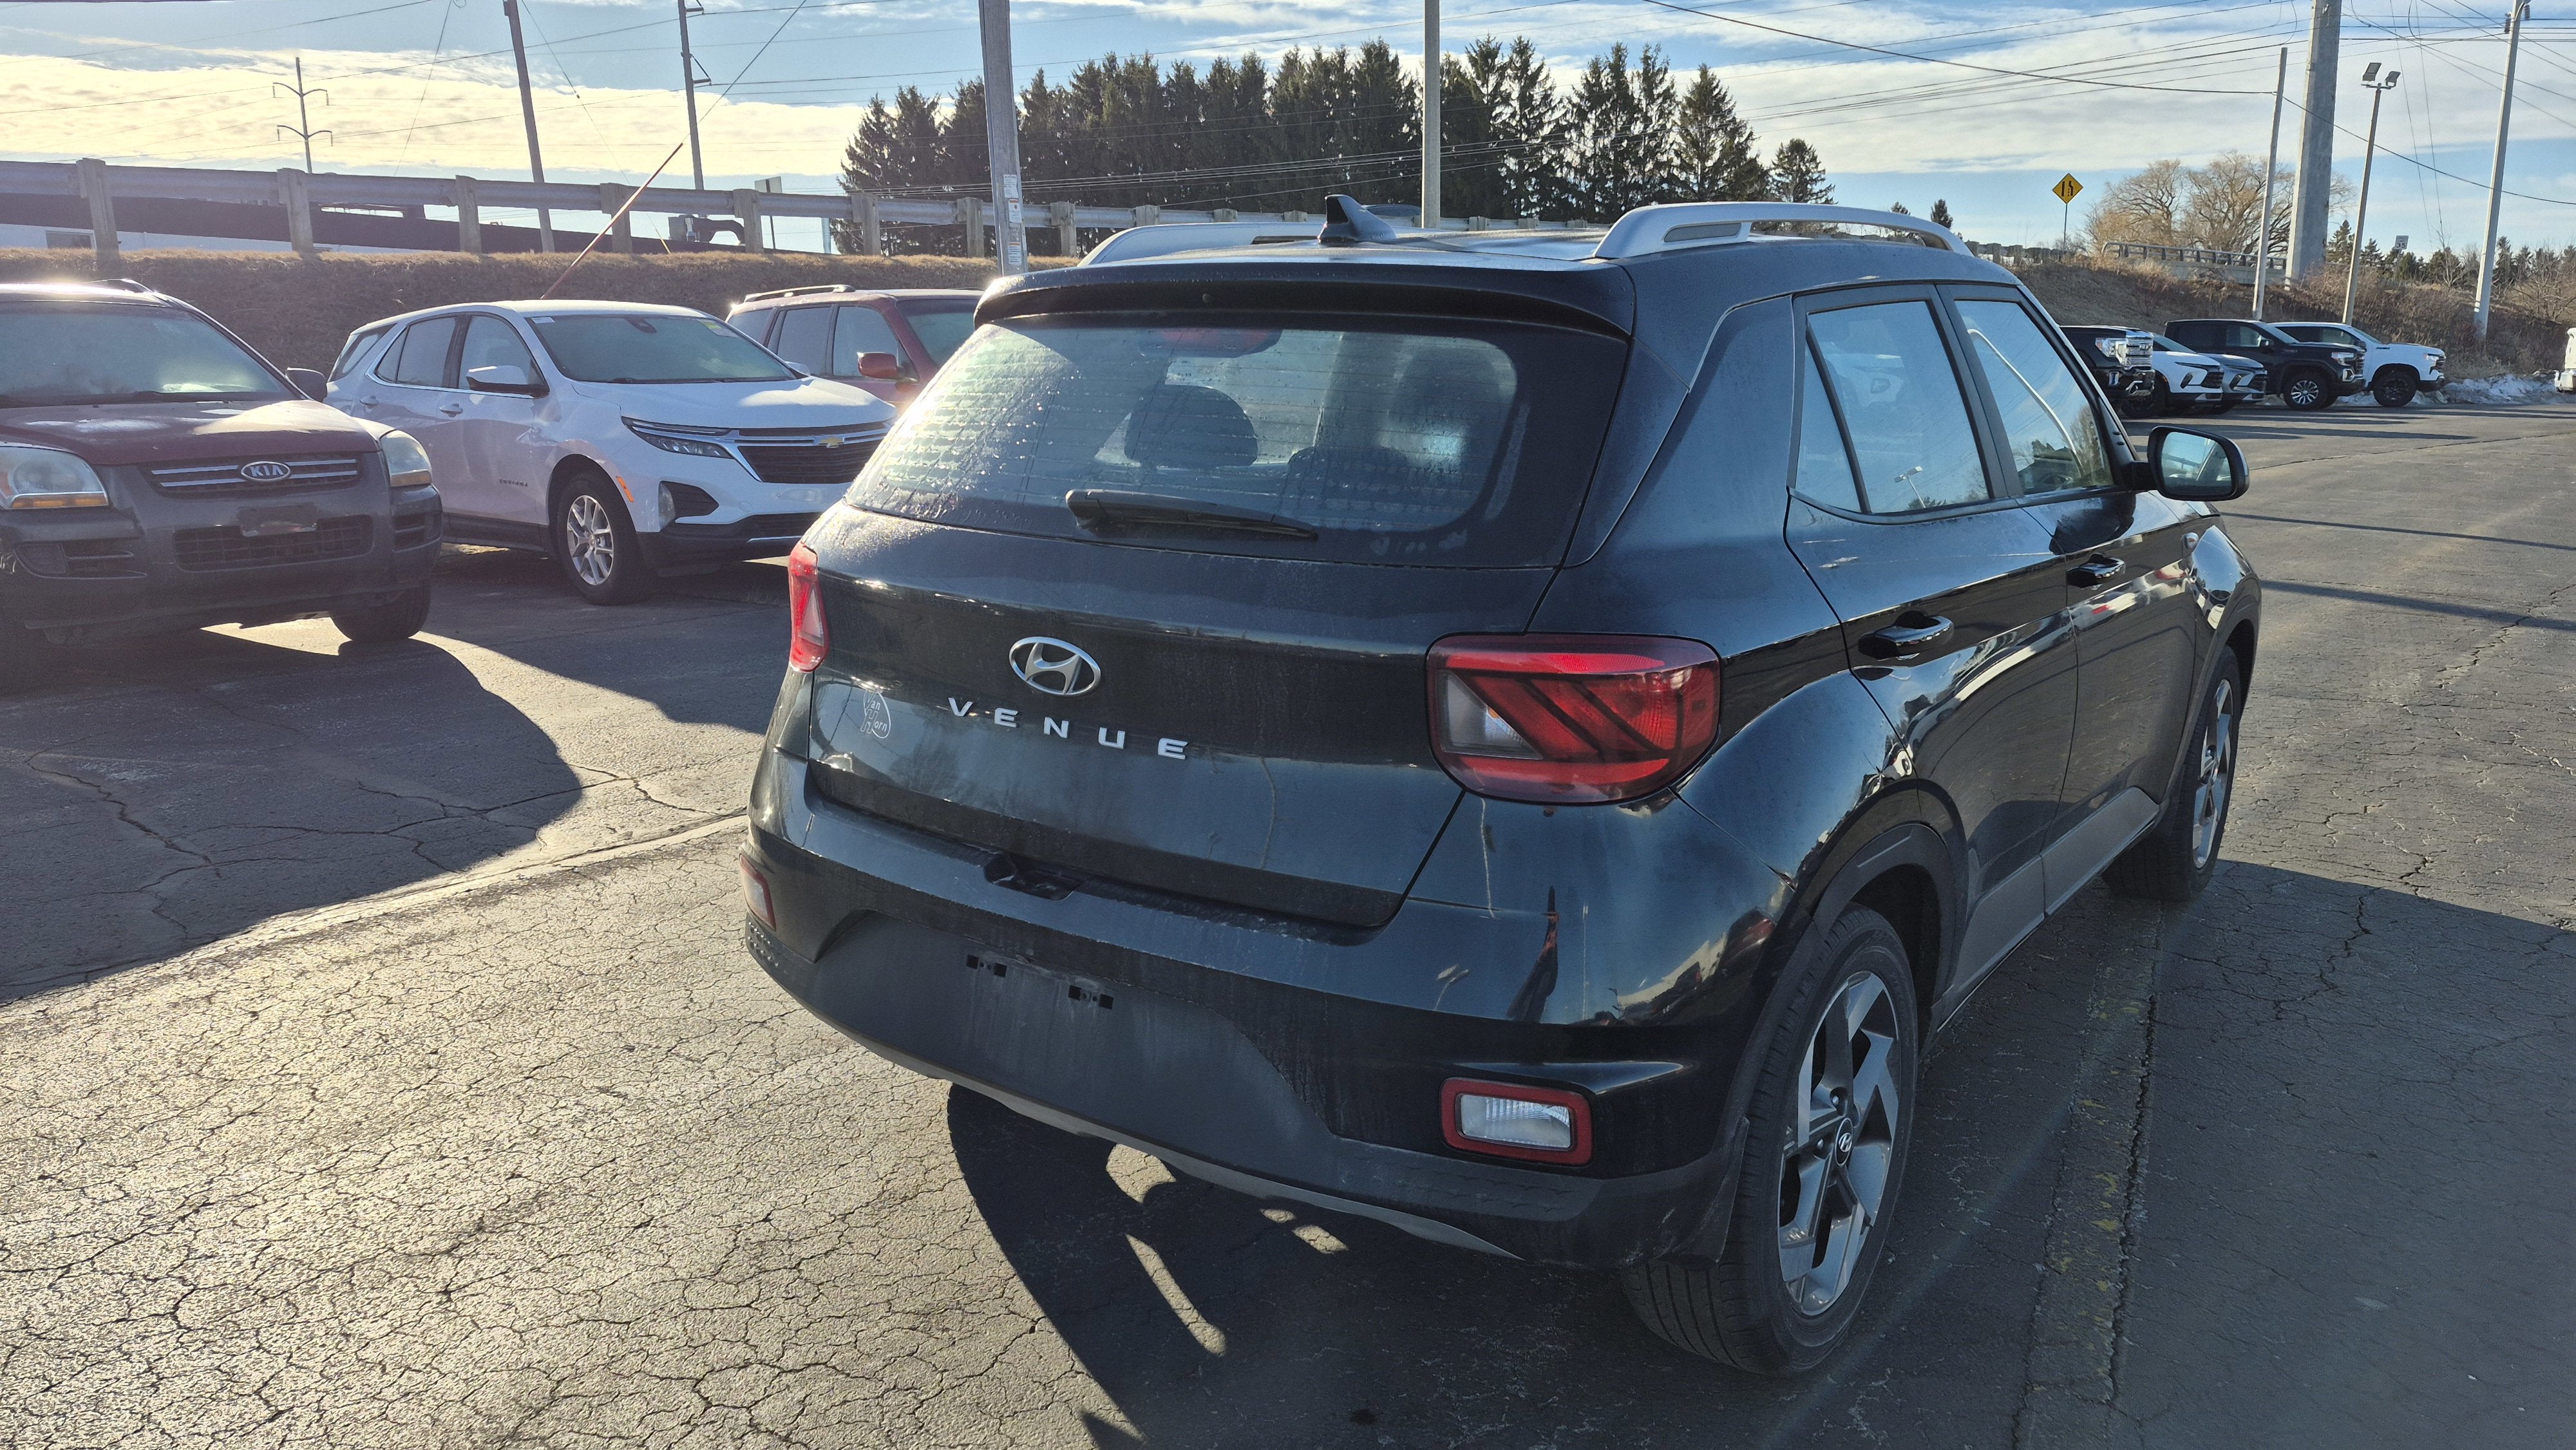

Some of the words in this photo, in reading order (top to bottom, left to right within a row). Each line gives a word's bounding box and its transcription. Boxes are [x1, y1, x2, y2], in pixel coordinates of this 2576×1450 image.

[249, 465, 284, 476] KIA
[864, 690, 881, 711] Van
[860, 709, 887, 734] Horn
[948, 697, 1188, 760] VENUE
